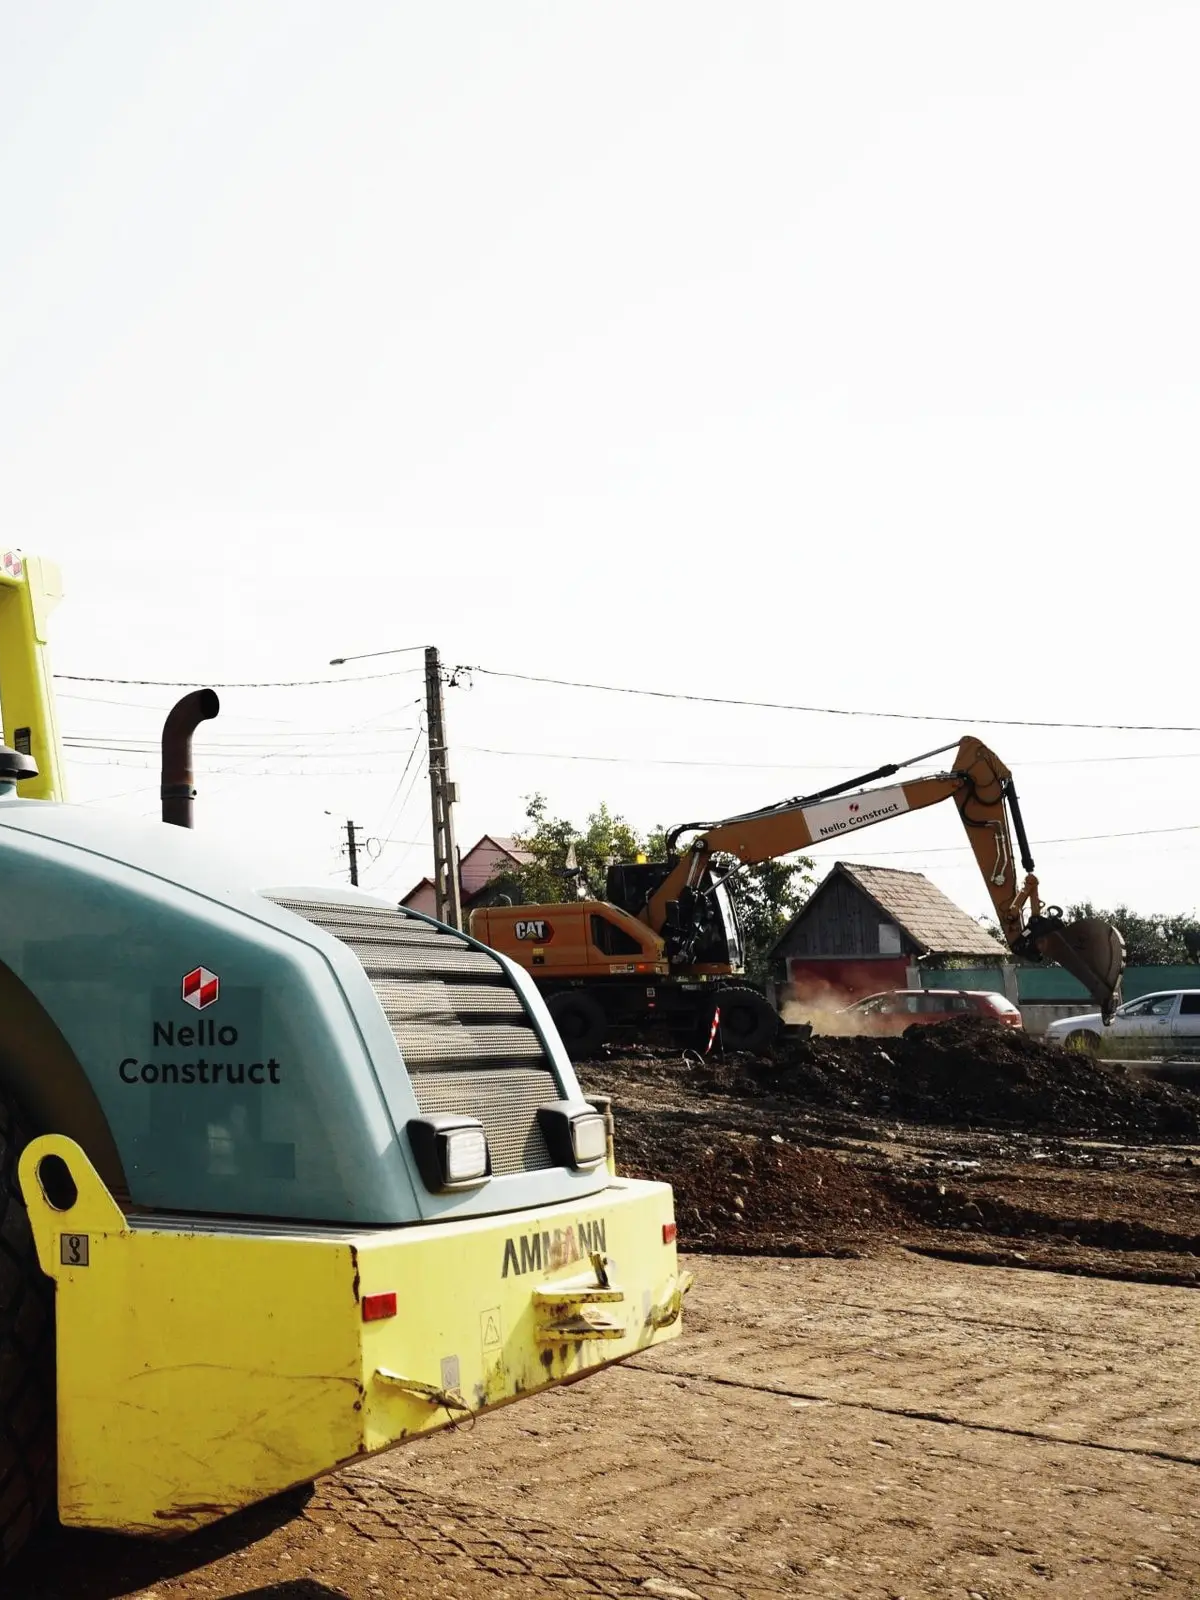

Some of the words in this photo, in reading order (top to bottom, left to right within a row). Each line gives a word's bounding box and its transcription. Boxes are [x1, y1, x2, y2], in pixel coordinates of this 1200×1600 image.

[820, 821, 847, 836] Nello
[848, 803, 899, 826] Construct
[514, 920, 545, 940] CAT
[153, 1019, 238, 1047] Nello
[119, 1057, 281, 1085] Construct
